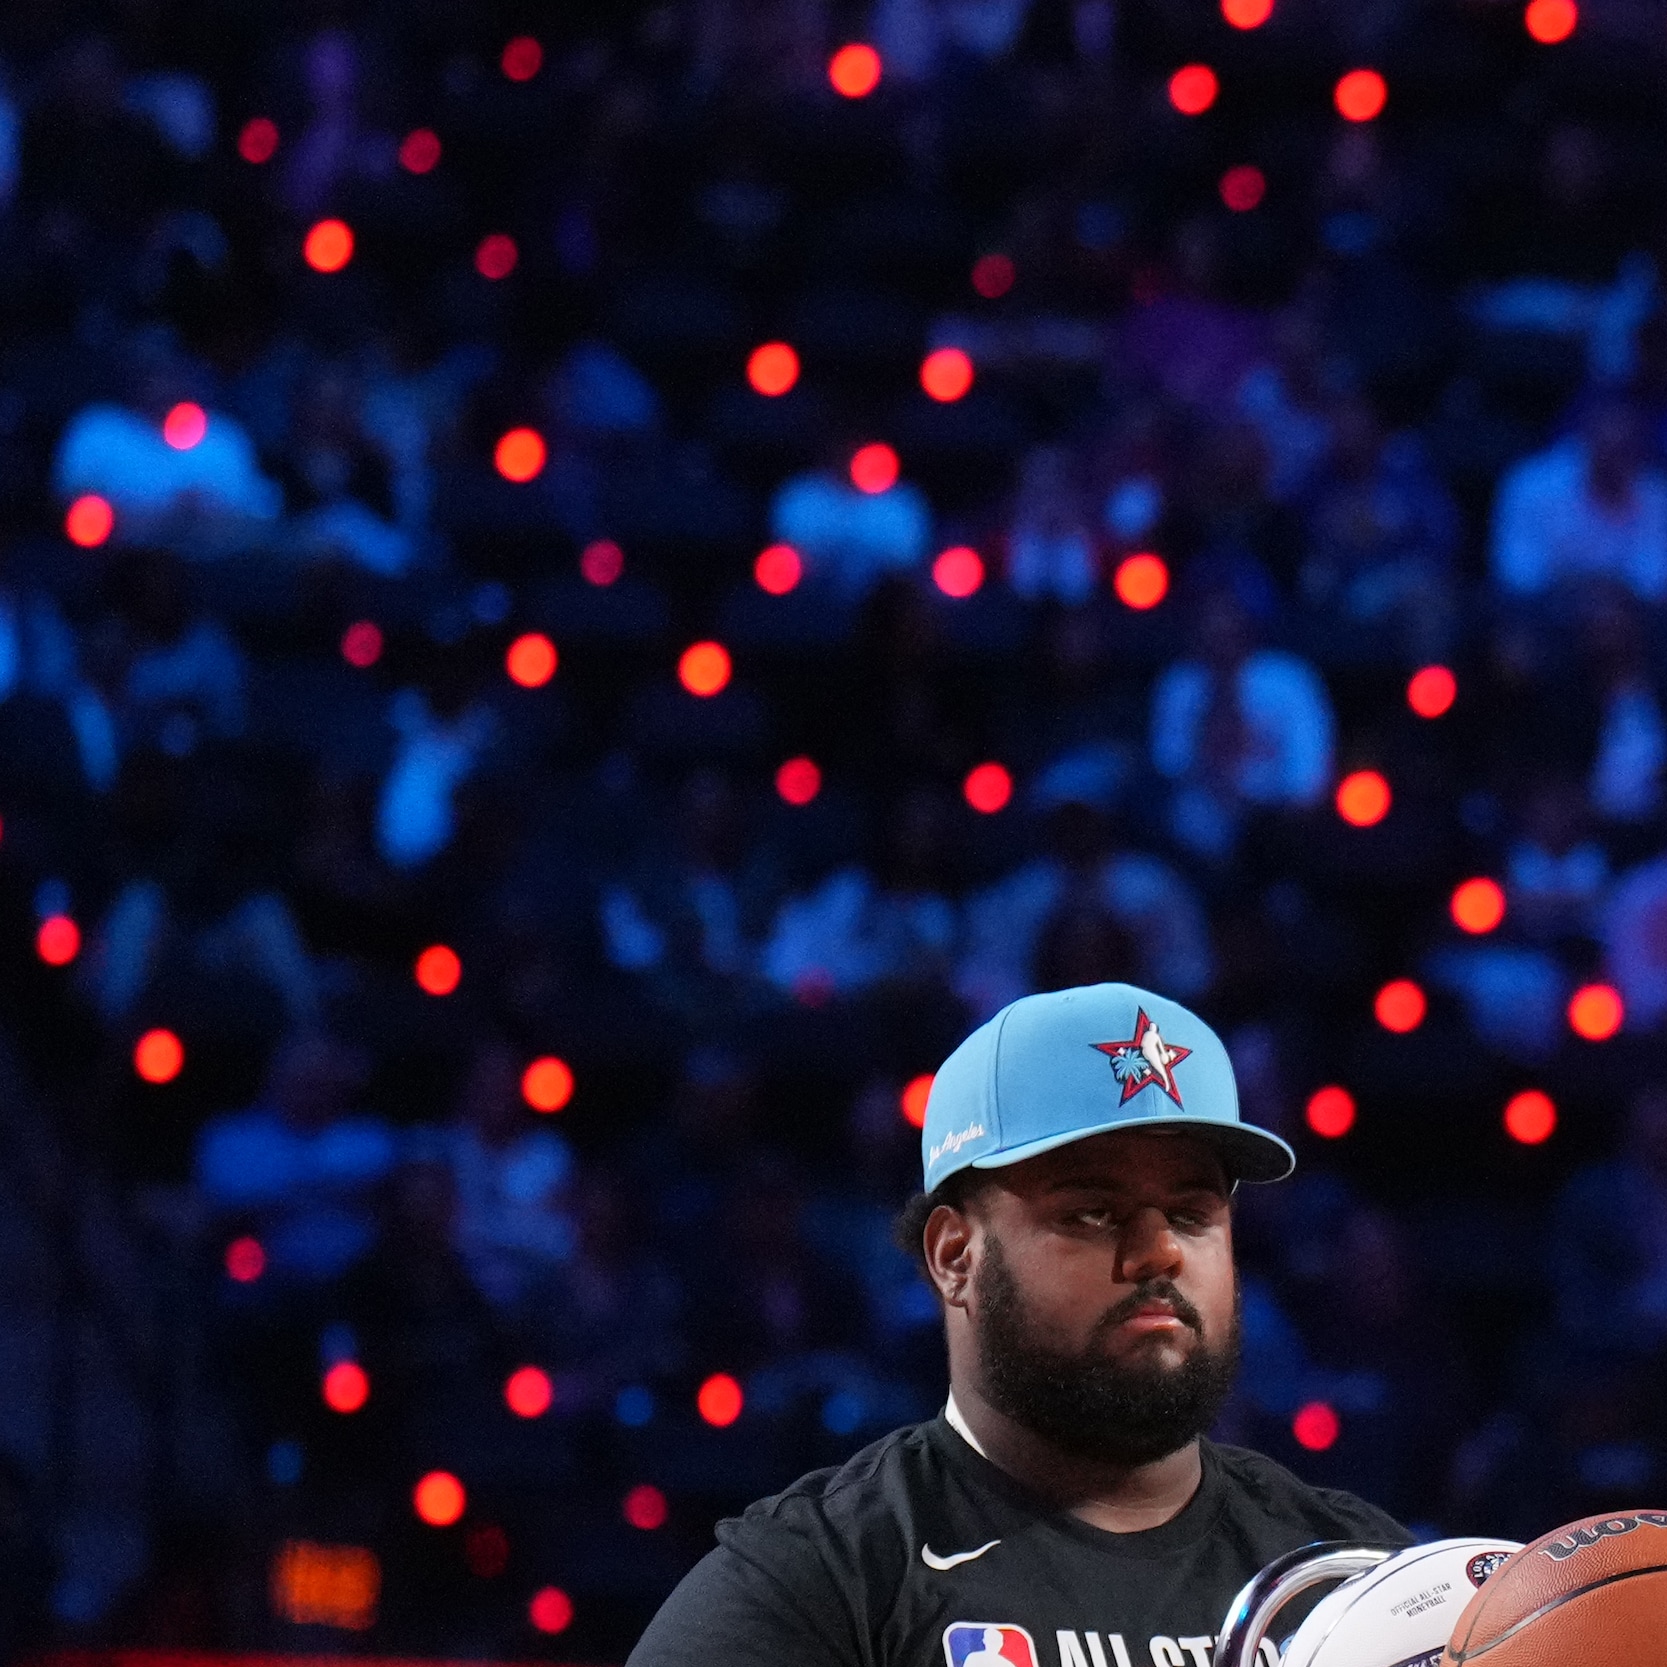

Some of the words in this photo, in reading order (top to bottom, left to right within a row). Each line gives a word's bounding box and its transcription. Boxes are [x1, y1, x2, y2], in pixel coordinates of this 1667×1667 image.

[1391, 1594, 1419, 1616] OFFICIAL
[1419, 1582, 1453, 1602] ALL-STAR
[1406, 1595, 1447, 1618] MONEYBALL
